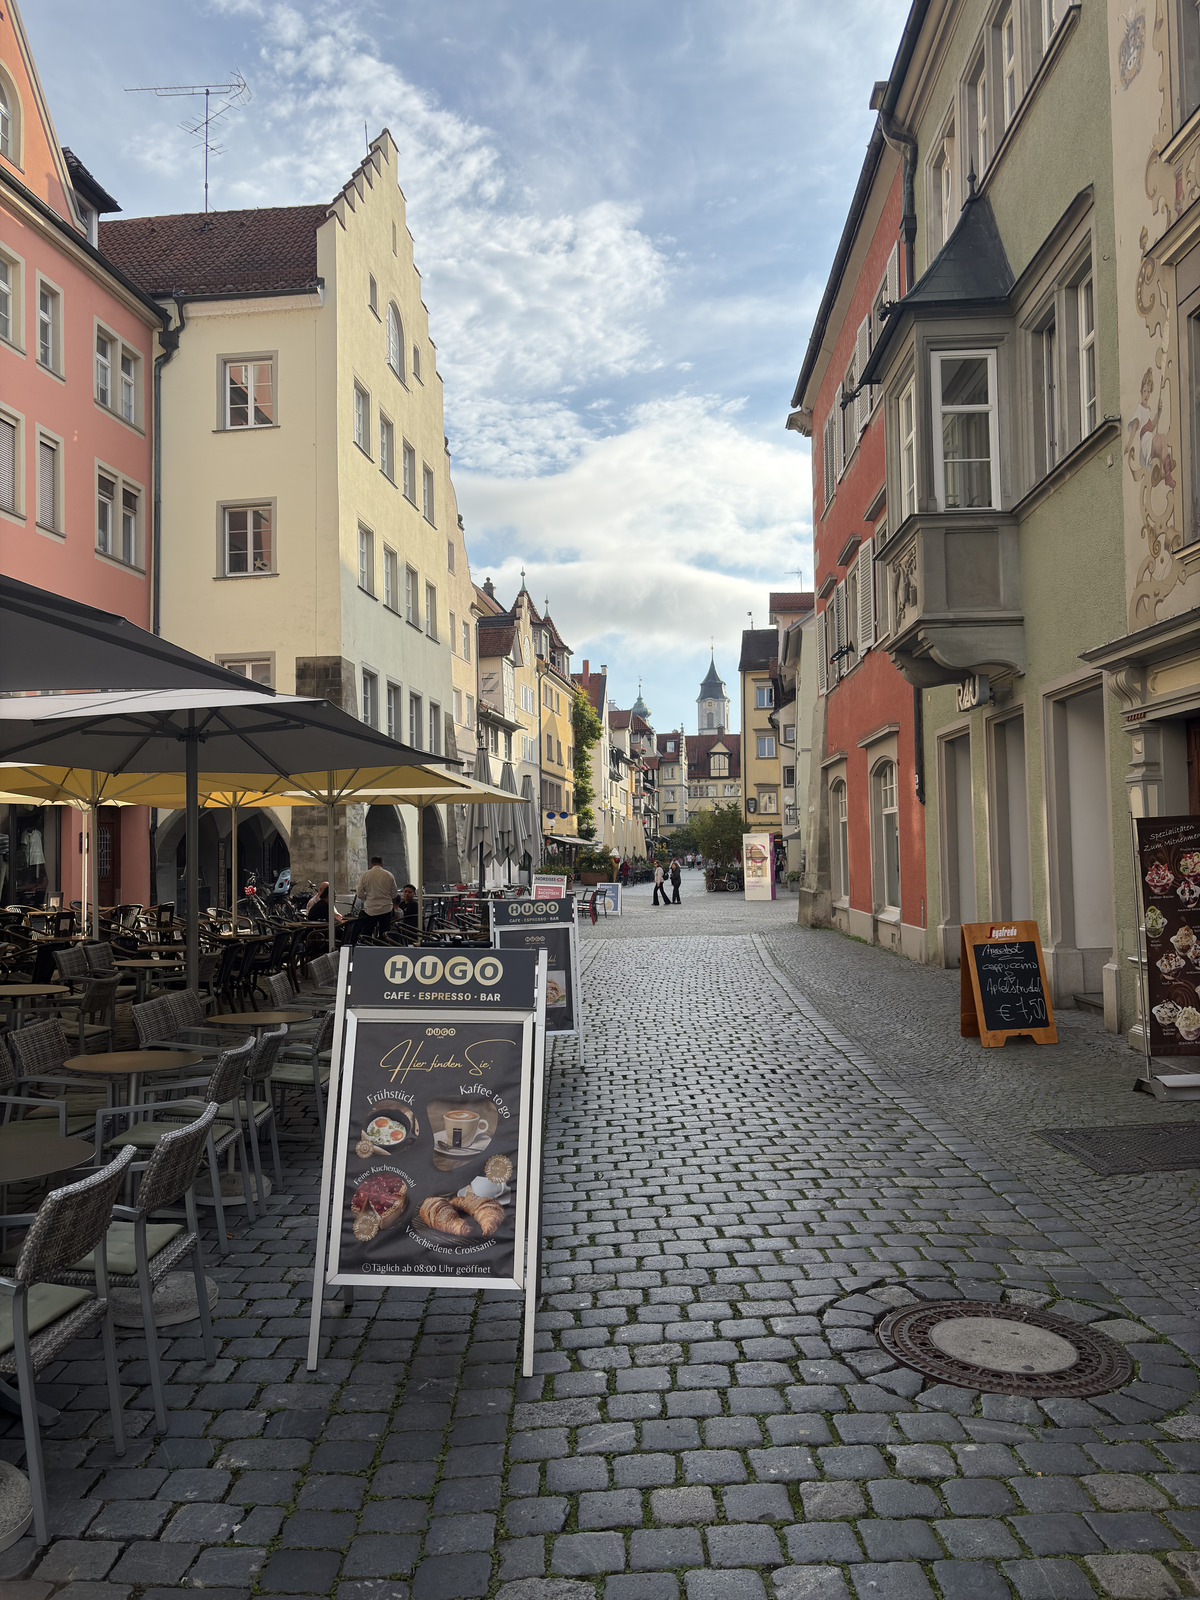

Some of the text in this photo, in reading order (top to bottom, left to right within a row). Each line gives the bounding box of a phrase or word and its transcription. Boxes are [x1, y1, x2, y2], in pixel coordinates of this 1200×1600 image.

[956, 674, 979, 712] RAU
[508, 902, 559, 916] HUGO
[986, 926, 1017, 940] Segafredo
[385, 957, 502, 985] HUGO
[384, 991, 501, 1001] CAFE ESPRESSO BAR
[426, 1028, 456, 1036] HUGO
[380, 1039, 427, 1084] Hier
[427, 1054, 463, 1072] finden
[366, 1088, 415, 1106] Frühstück
[459, 1083, 511, 1119] Kaffee to go
[353, 1164, 417, 1188] Feine Kuchenauswahl
[405, 1225, 497, 1255] Verschiedene Croissants
[371, 1263, 491, 1275] Täglich ab 08:00 Uhr geöffnet
